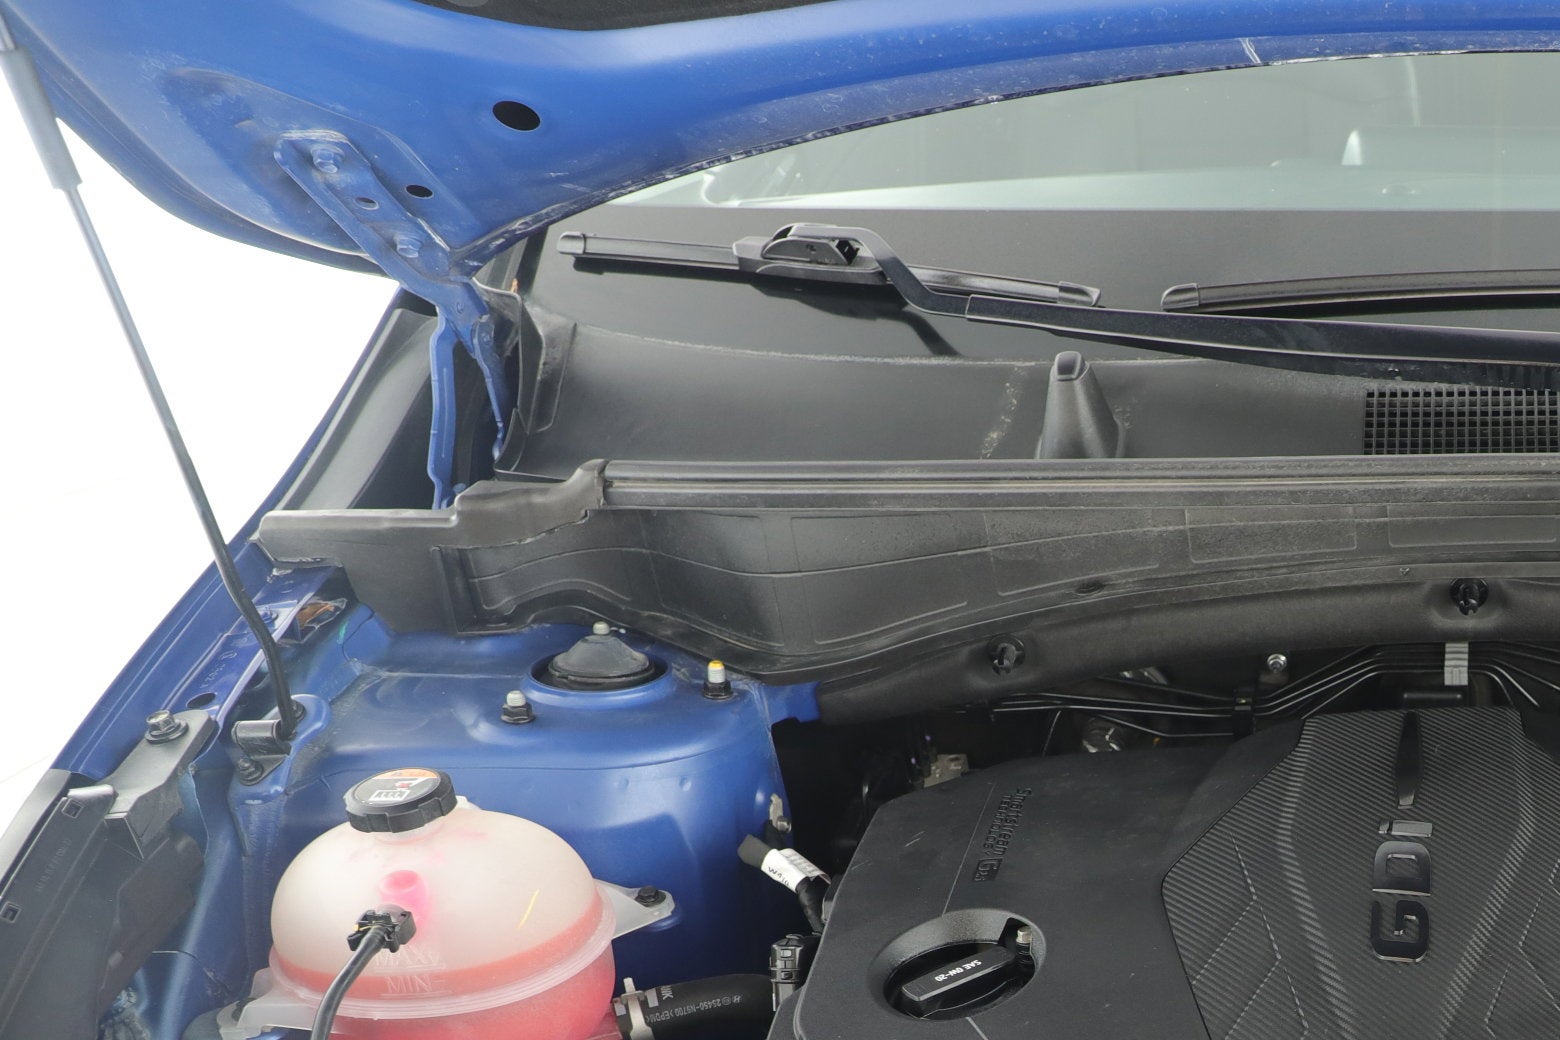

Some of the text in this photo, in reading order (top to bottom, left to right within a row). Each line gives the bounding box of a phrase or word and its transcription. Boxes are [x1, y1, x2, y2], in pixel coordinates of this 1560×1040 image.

[934, 959, 982, 983] SAE 0W-20
[384, 976, 434, 993] MIN
